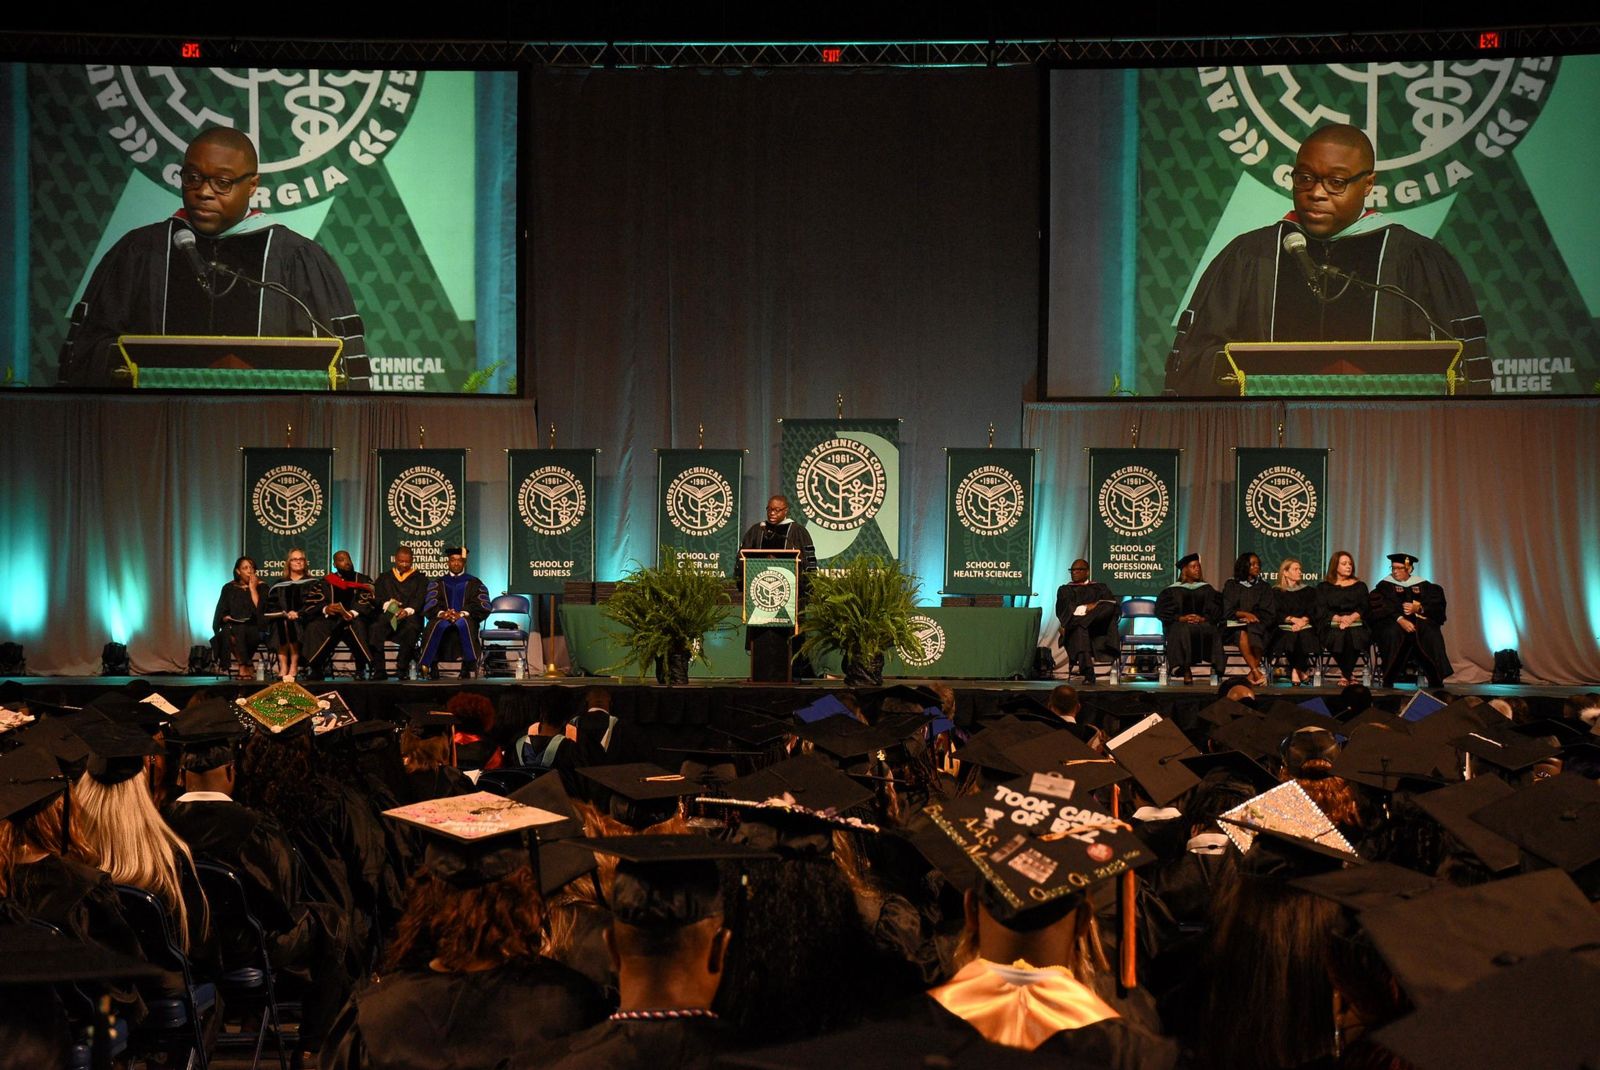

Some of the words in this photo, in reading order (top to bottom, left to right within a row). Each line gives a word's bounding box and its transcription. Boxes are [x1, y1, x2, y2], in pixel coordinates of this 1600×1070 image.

[162, 163, 349, 208] GRGIA
[1273, 160, 1474, 208] GRGIA
[370, 357, 445, 373] CHNICAL
[1492, 357, 1575, 375] CHNICAL
[369, 374, 425, 391] LLEGE
[1491, 375, 1552, 393] LLEGE
[832, 454, 849, 463] 1961
[796, 454, 813, 505] AUGUSTA
[811, 439, 870, 457] TECHNICAL
[870, 456, 885, 505] COLLEGE
[1274, 478, 1289, 486] 1961
[253, 478, 266, 516] AUGUSTA
[265, 465, 312, 479] TECHNICAL
[311, 479, 323, 516] COLLEGE
[387, 479, 401, 516] AUGUSTA
[399, 466, 445, 480] TECHNICAL
[444, 480, 456, 516] COLLEGE
[518, 478, 531, 516] AUGUSTA
[529, 466, 576, 480] TECHNICAL
[574, 480, 586, 516] COLLEGE
[666, 479, 680, 516] AUGUSTA
[678, 467, 722, 481] TECHNICAL
[722, 481, 733, 518] COLLEGE
[955, 478, 969, 516] AUGUSTA
[967, 465, 1014, 480] TECHNICAL
[1012, 480, 1024, 517] COLLEGE
[1098, 478, 1112, 517] AUGUSTA
[1110, 466, 1158, 480] TECHNICAL
[1157, 480, 1169, 517] COLLEGE
[1245, 478, 1259, 518] AUGUSTA
[1258, 466, 1306, 481] TECHNICAL
[1305, 480, 1317, 518] COLLEGE
[815, 518, 866, 530] GEORGIA
[267, 526, 307, 535] GEORGIA
[403, 526, 442, 536] GEORGIA
[533, 526, 571, 535] GEORGIA
[680, 526, 718, 536] GEORGIA
[970, 526, 1008, 536] GEORGIA
[1113, 527, 1153, 537] GEORGIA
[1260, 528, 1300, 538] GEORGIA
[400, 540, 431, 548] SCHOOL
[434, 540, 444, 548] OF
[1110, 544, 1144, 552] SCHOOL
[1144, 544, 1156, 552] OF
[411, 548, 442, 556] IATION,
[676, 552, 708, 560] SCHOOL
[710, 552, 720, 560] OF
[264, 560, 286, 568] SCHO
[530, 560, 562, 568] SCHOOL
[563, 560, 574, 568] OF
[1102, 562, 1163, 570] PROFESSIONAL
[954, 570, 984, 578] HEALTH
[985, 570, 1022, 578] SCIENCES
[1114, 572, 1152, 580] SERVICES
[994, 785, 1056, 816] TOOK
[1011, 810, 1045, 826] OF
